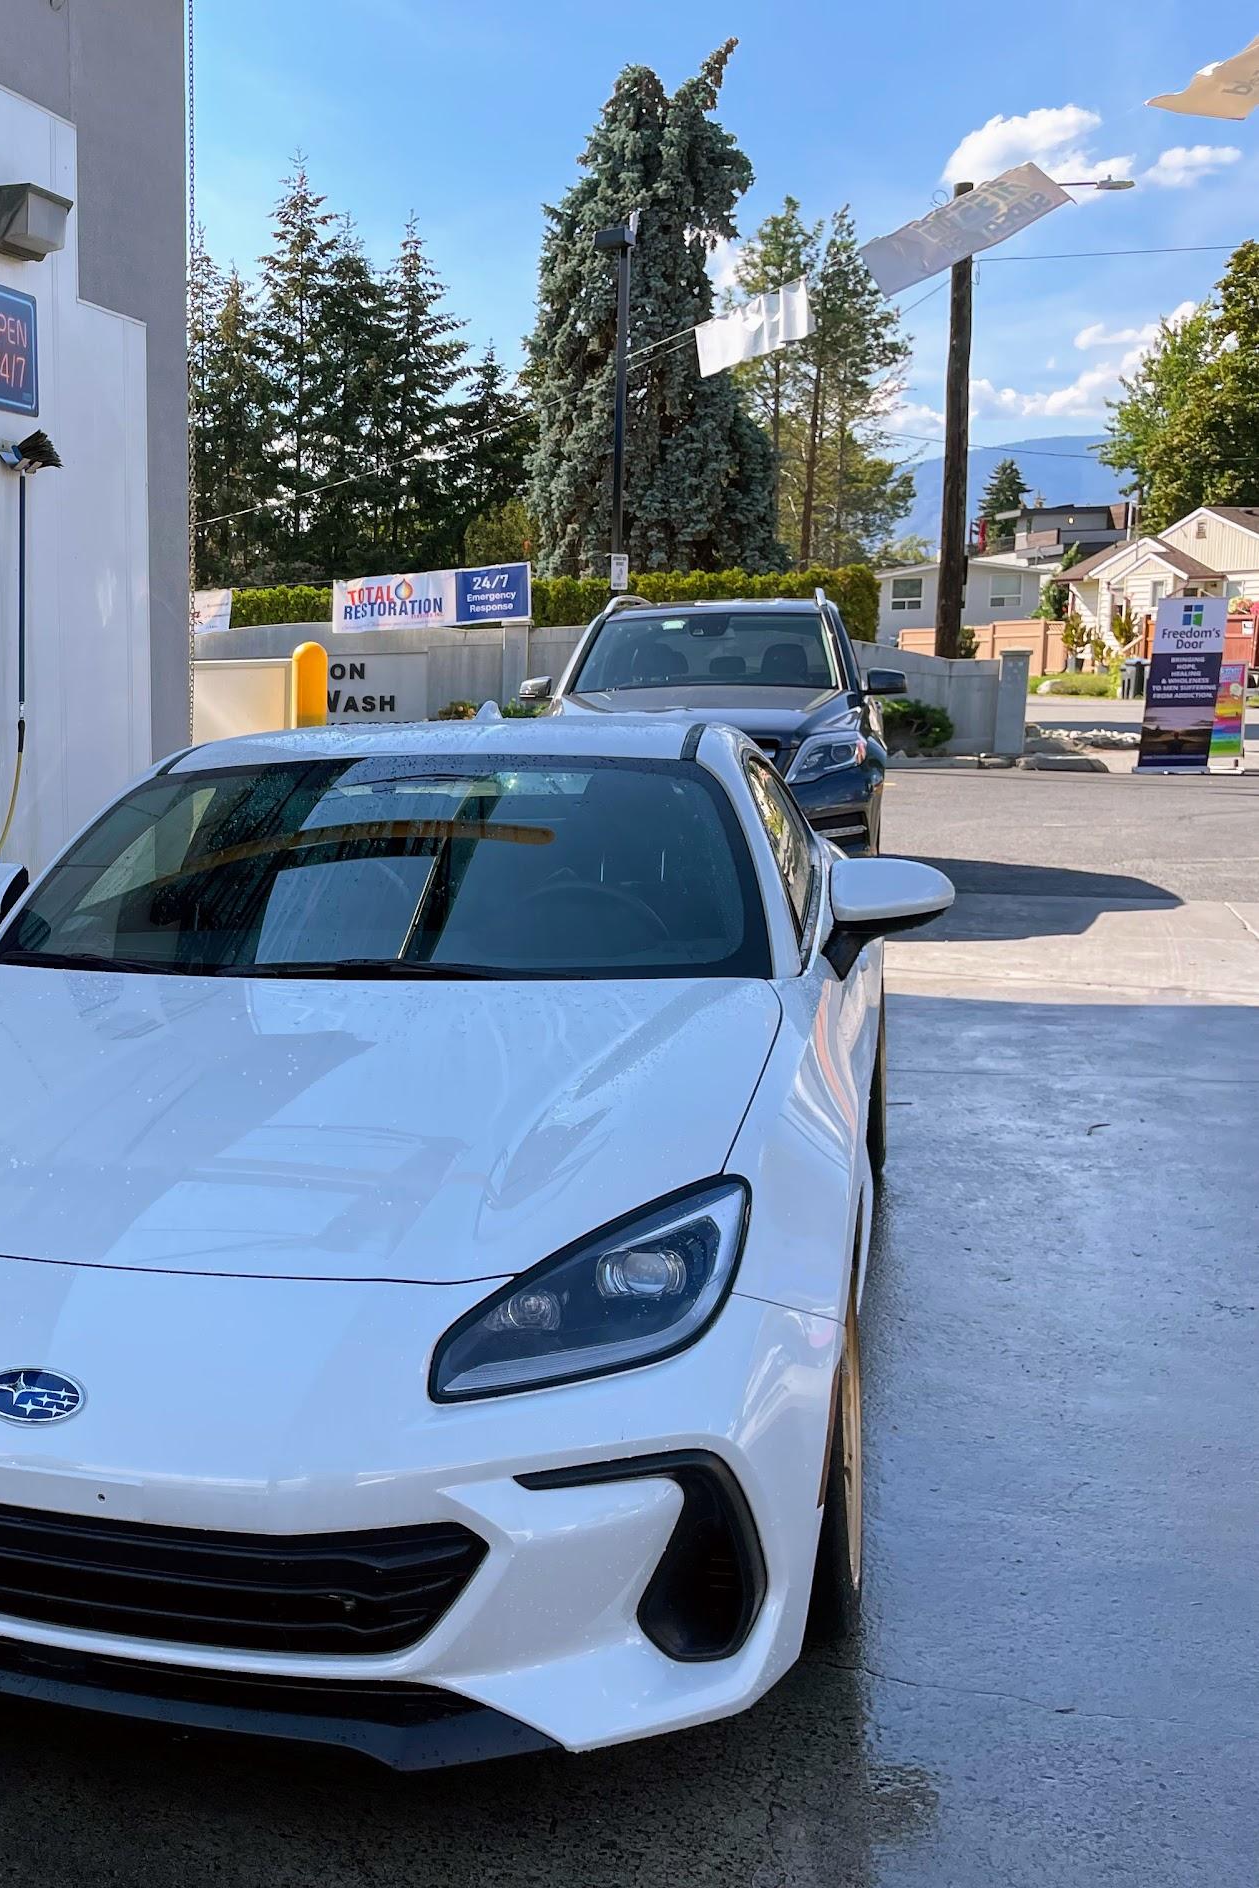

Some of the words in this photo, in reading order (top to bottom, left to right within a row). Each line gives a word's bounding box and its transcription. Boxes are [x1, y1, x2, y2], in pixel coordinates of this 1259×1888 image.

[472, 573, 509, 590] 24/7
[347, 585, 394, 606] TOTAL
[466, 591, 516, 602] Emergency
[343, 597, 443, 620] RESTORATION
[469, 603, 513, 613] Response
[1162, 627, 1221, 639] Freedom's
[1176, 639, 1204, 649] Door
